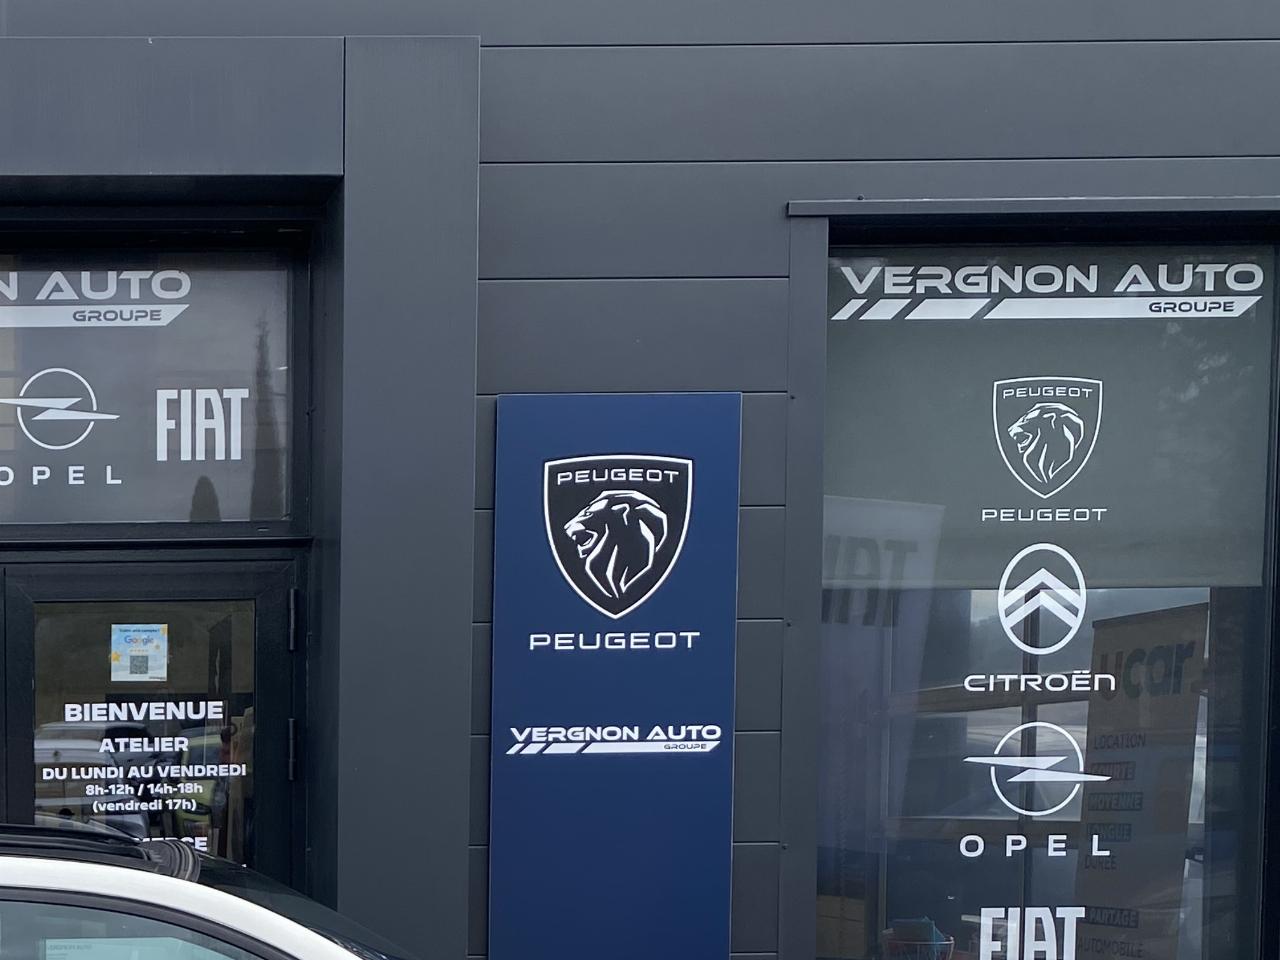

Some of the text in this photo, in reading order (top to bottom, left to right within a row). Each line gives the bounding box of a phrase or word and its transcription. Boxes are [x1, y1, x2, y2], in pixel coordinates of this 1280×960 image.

[35, 270, 192, 301] AUTO
[840, 263, 1264, 295] VERGNON AUTO
[72, 309, 162, 322] GROUPE
[1148, 301, 1235, 313] GROUPE
[1003, 386, 1093, 399] PEUGEOT
[156, 388, 249, 462] FIAT
[557, 468, 679, 486] PEUGEOT
[981, 508, 1108, 522] PEUGEOT
[529, 631, 701, 651] PEUGEOT
[963, 669, 1116, 692] CITROËN
[64, 700, 224, 722] BIENVENUE
[510, 724, 722, 743] VERGNON AUTO
[98, 736, 189, 754] ATELIER
[663, 742, 708, 751] GROUPE
[42, 763, 247, 780] DU LUNDI AU VENDREDI
[85, 782, 204, 796] 8h-12h / 14h-18h
[92, 798, 197, 814] (vendredi 17h)
[959, 834, 1111, 858] OPEL
